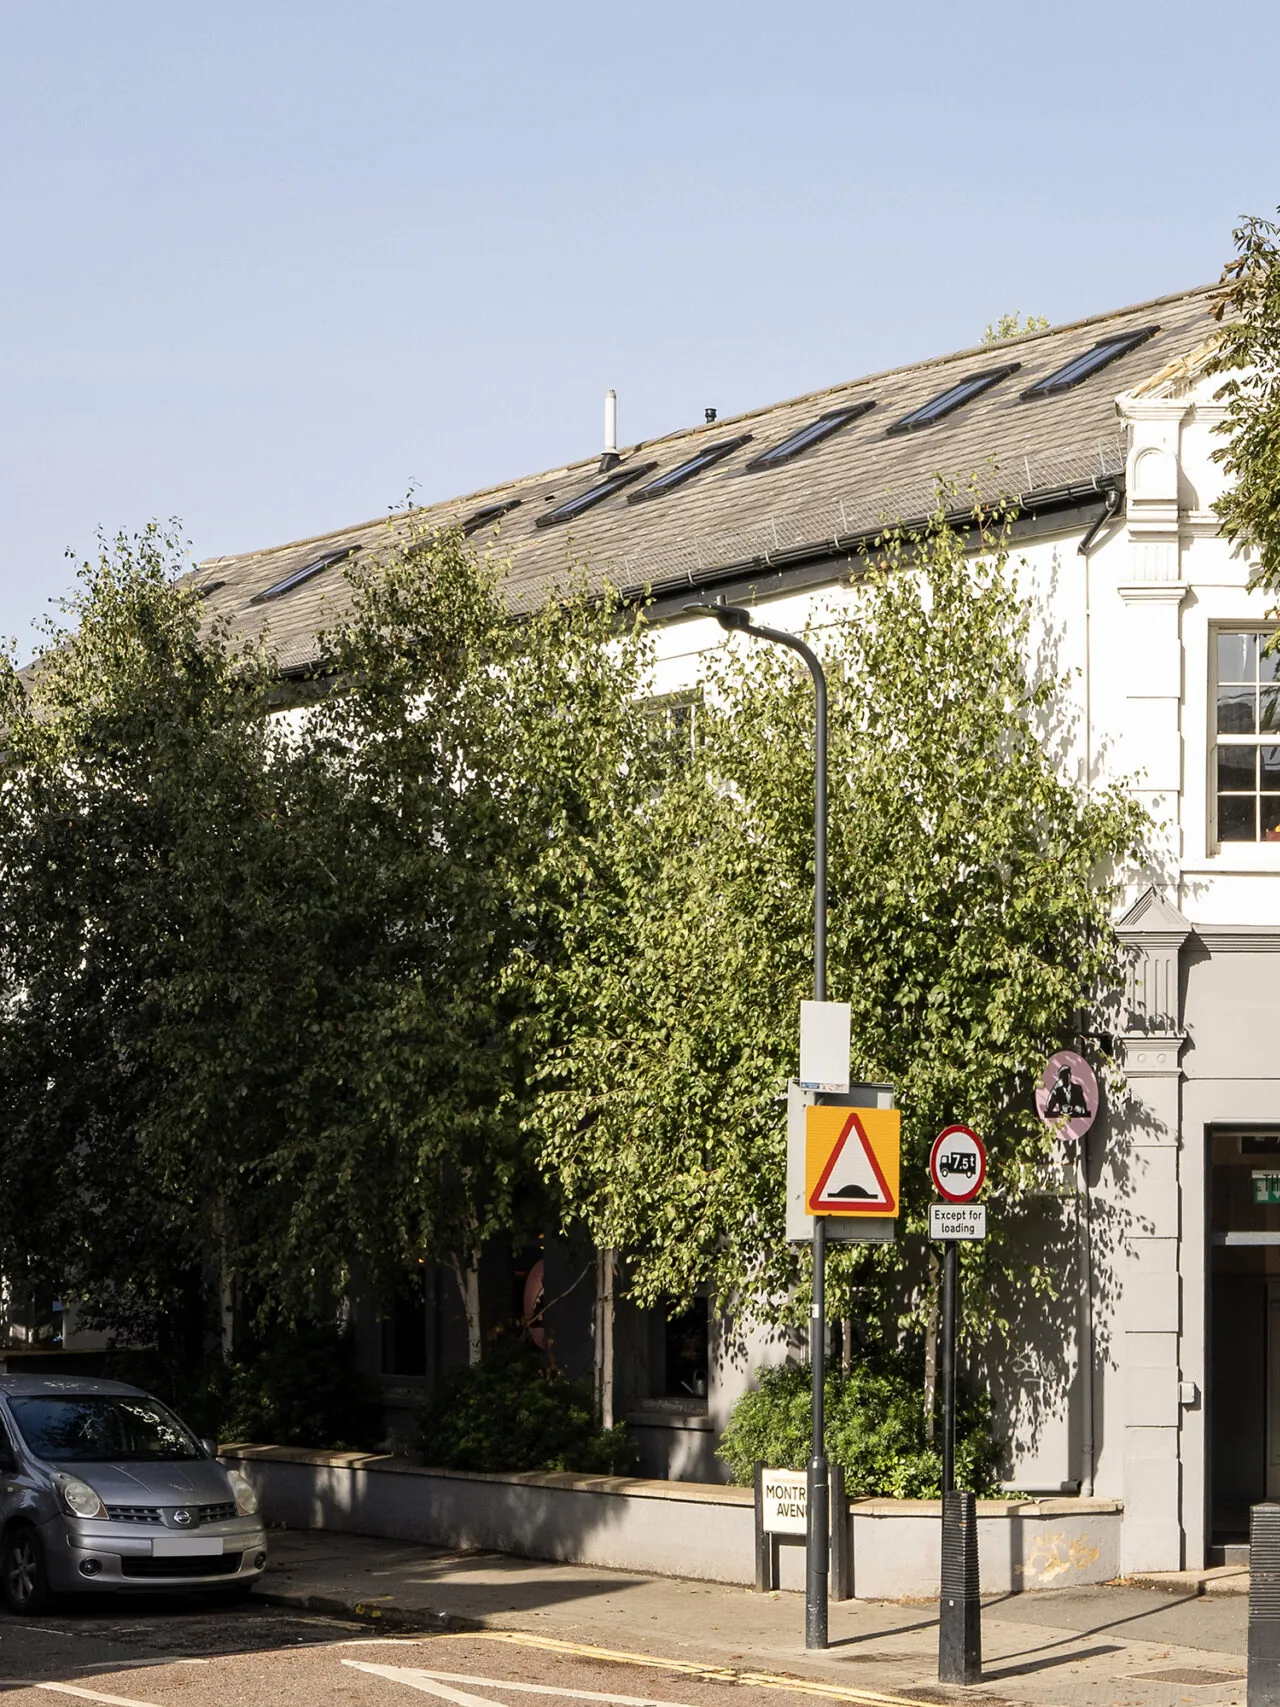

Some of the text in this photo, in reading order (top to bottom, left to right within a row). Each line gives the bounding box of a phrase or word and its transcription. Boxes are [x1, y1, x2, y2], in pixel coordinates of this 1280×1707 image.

[934, 1210, 982, 1222] Except for
[941, 1223, 975, 1235] loading
[766, 1485, 807, 1501] MONTR
[776, 1503, 807, 1518] AVEN
